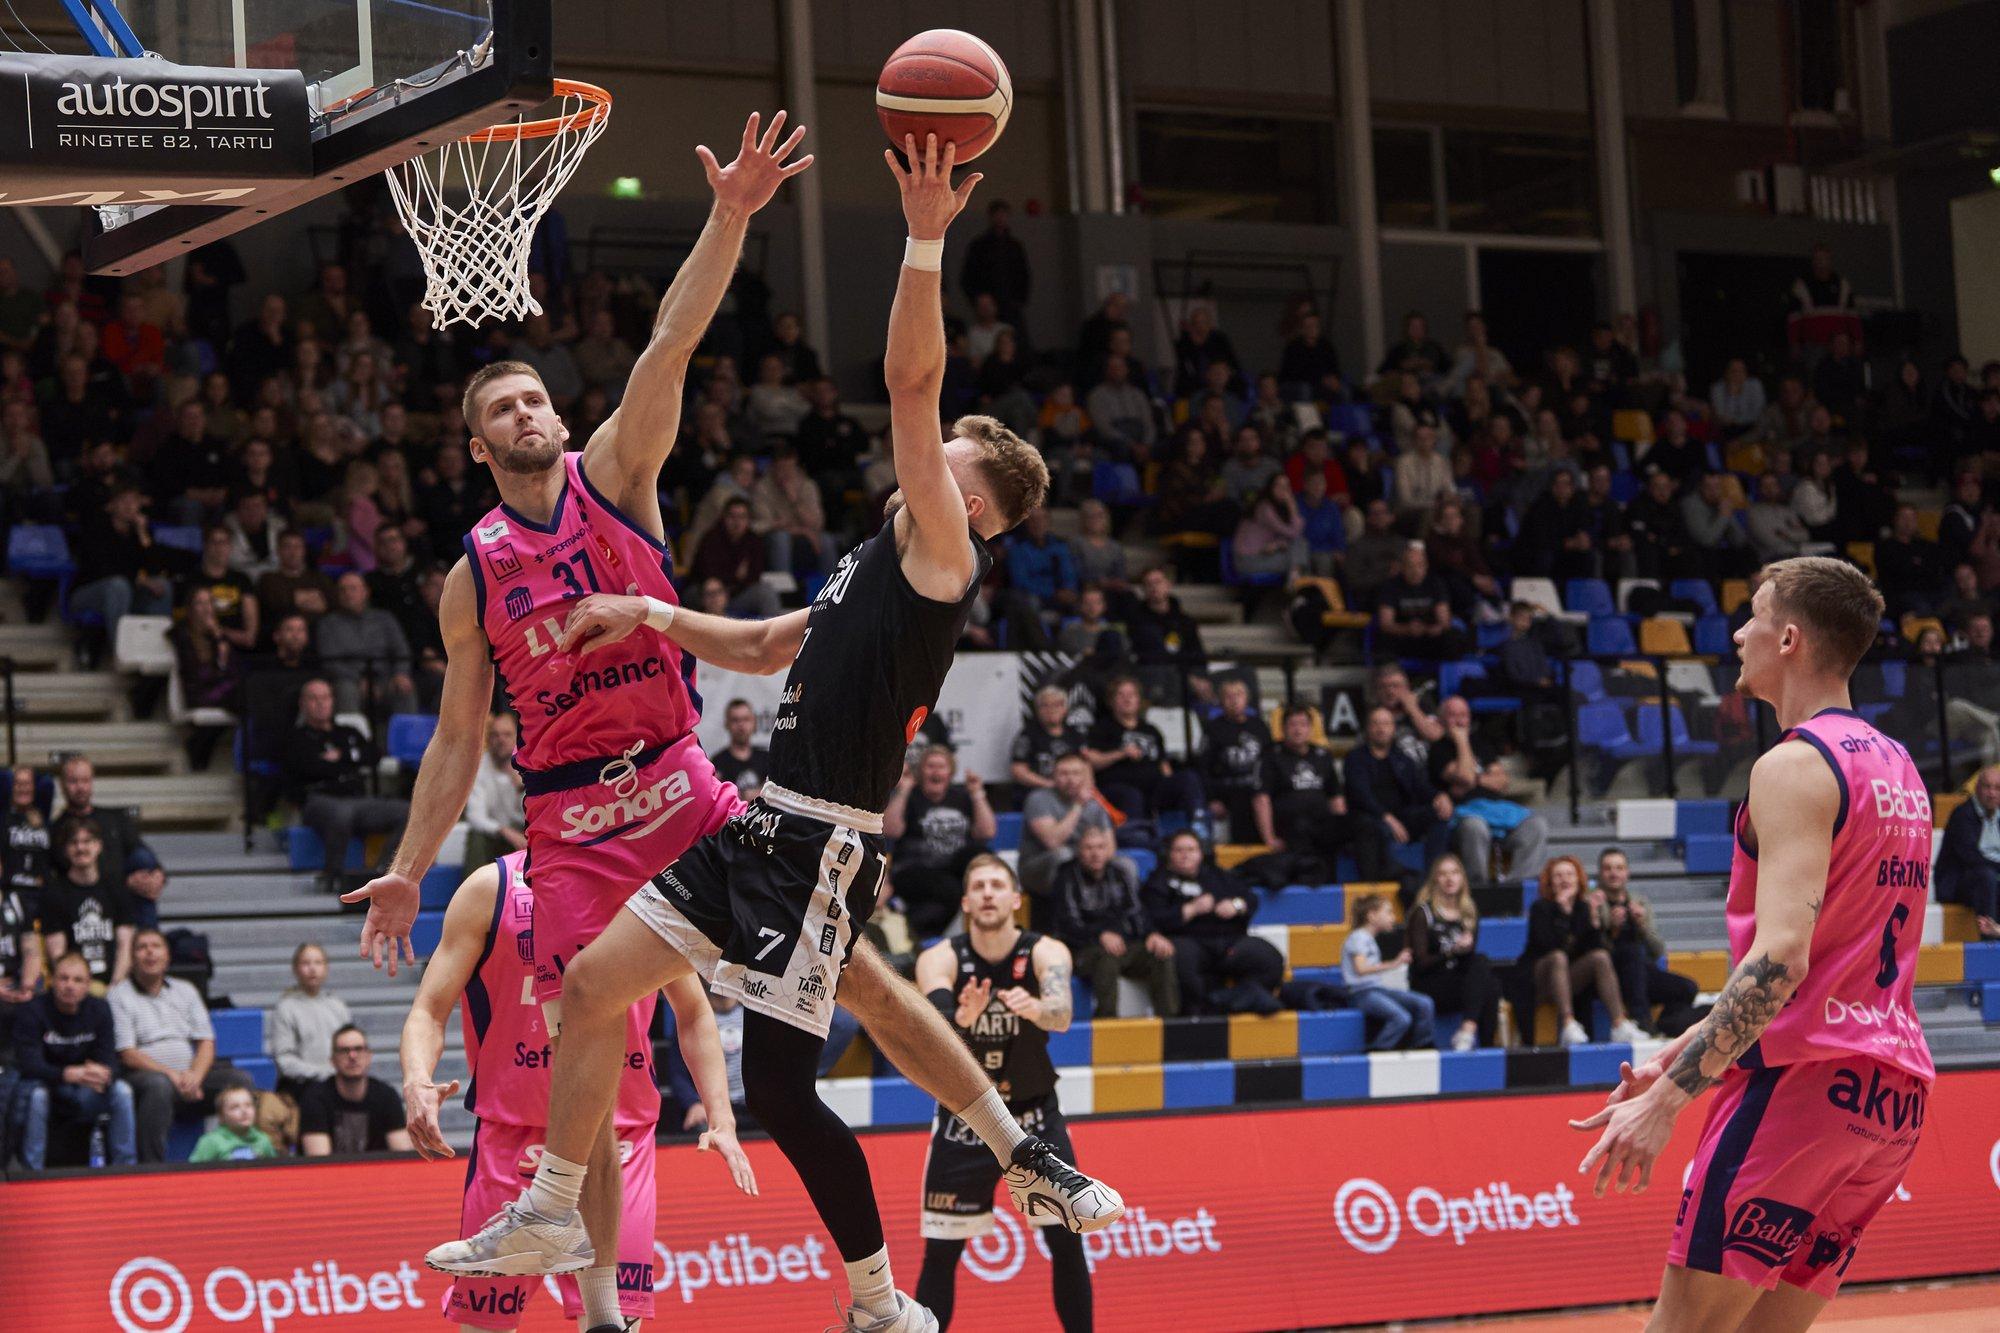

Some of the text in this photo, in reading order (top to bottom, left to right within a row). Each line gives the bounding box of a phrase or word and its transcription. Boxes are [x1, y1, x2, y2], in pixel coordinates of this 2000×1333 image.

[56, 75, 273, 129] autospirit
[59, 133, 273, 150] RINGTEE 82, TARTU
[496, 556, 516, 573] Tu
[552, 548, 601, 600] 37
[1330, 692, 1359, 732] A
[662, 868, 693, 901] Express
[754, 926, 786, 961] 7
[821, 928, 836, 954] BALLZY
[797, 976, 827, 1001] TARTU
[985, 1051, 1004, 1069] 9
[927, 1191, 958, 1209] LUX
[1406, 1181, 1580, 1246] Optibet
[203, 1259, 426, 1333] Optibet
